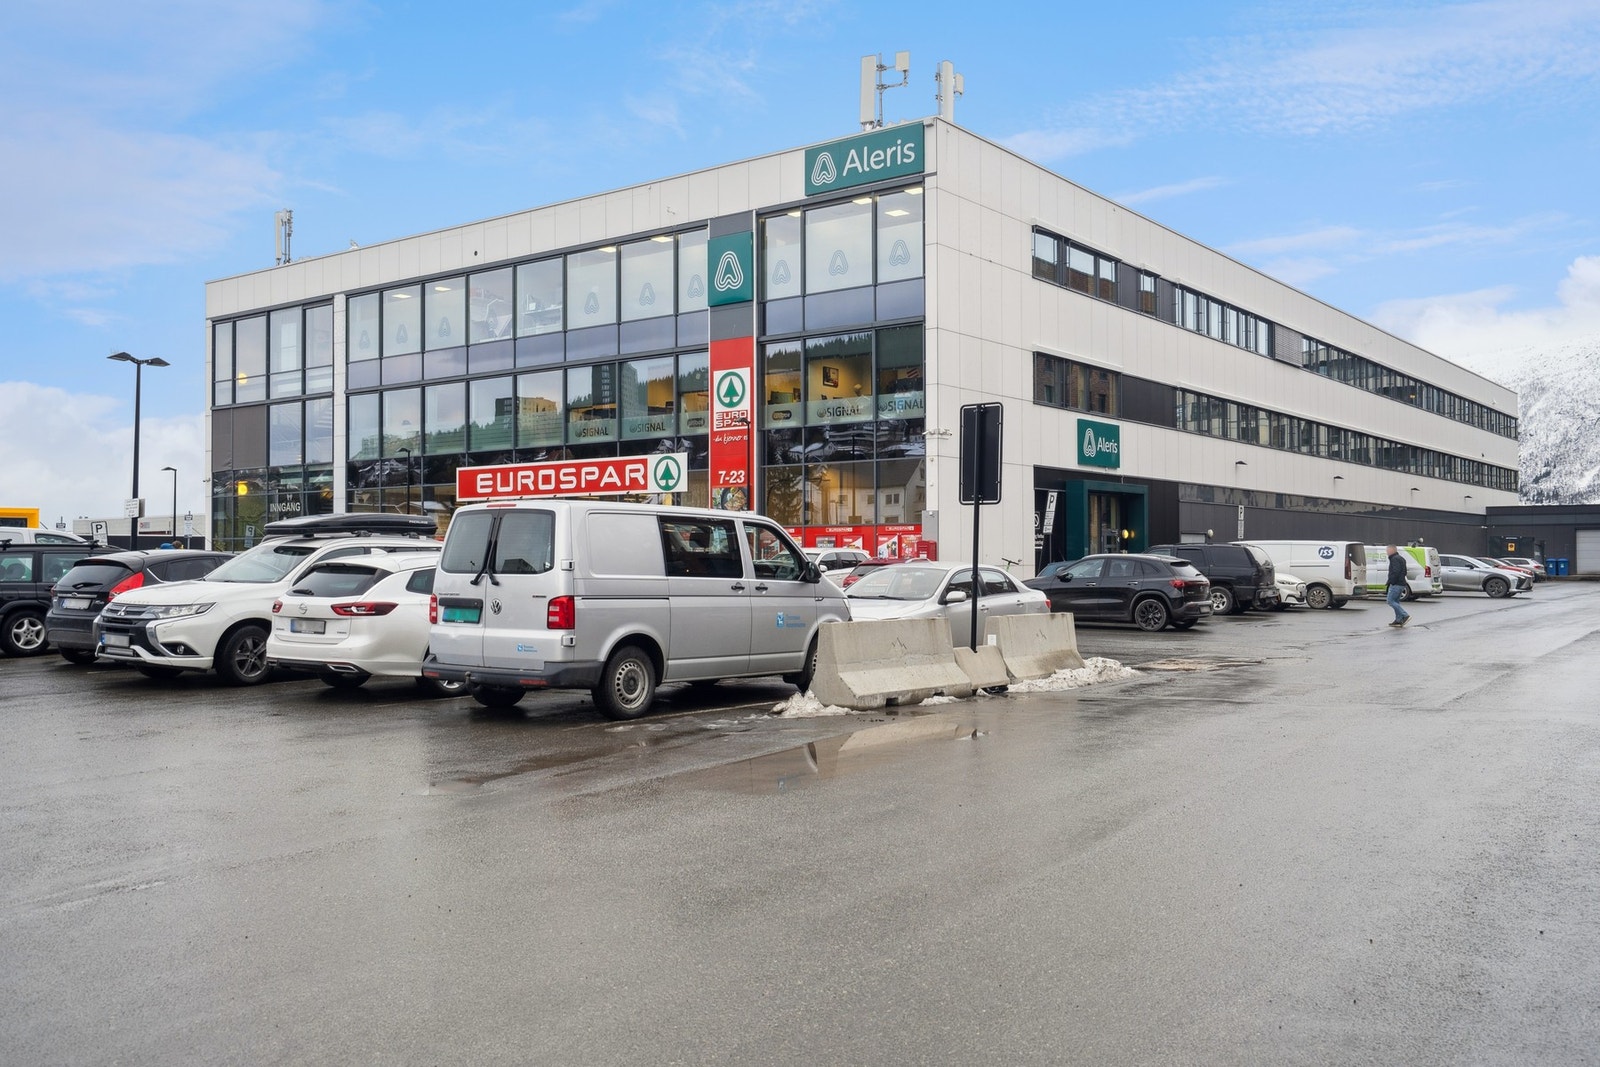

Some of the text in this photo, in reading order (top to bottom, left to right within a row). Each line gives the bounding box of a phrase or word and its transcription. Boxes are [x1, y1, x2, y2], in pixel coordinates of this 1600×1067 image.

[842, 138, 916, 177] Aleris
[827, 404, 862, 418] SIGNAL
[887, 399, 924, 412] SIGNAL
[715, 410, 748, 420] EURO
[582, 427, 609, 438] SIGNAL
[636, 422, 666, 433] SIGNAL
[1097, 436, 1118, 454] Aleris
[476, 463, 645, 494] EUROSPAR
[718, 470, 745, 485] 7-23
[269, 502, 301, 513] INNGANG
[1048, 494, 1055, 509] P
[95, 524, 103, 533] P
